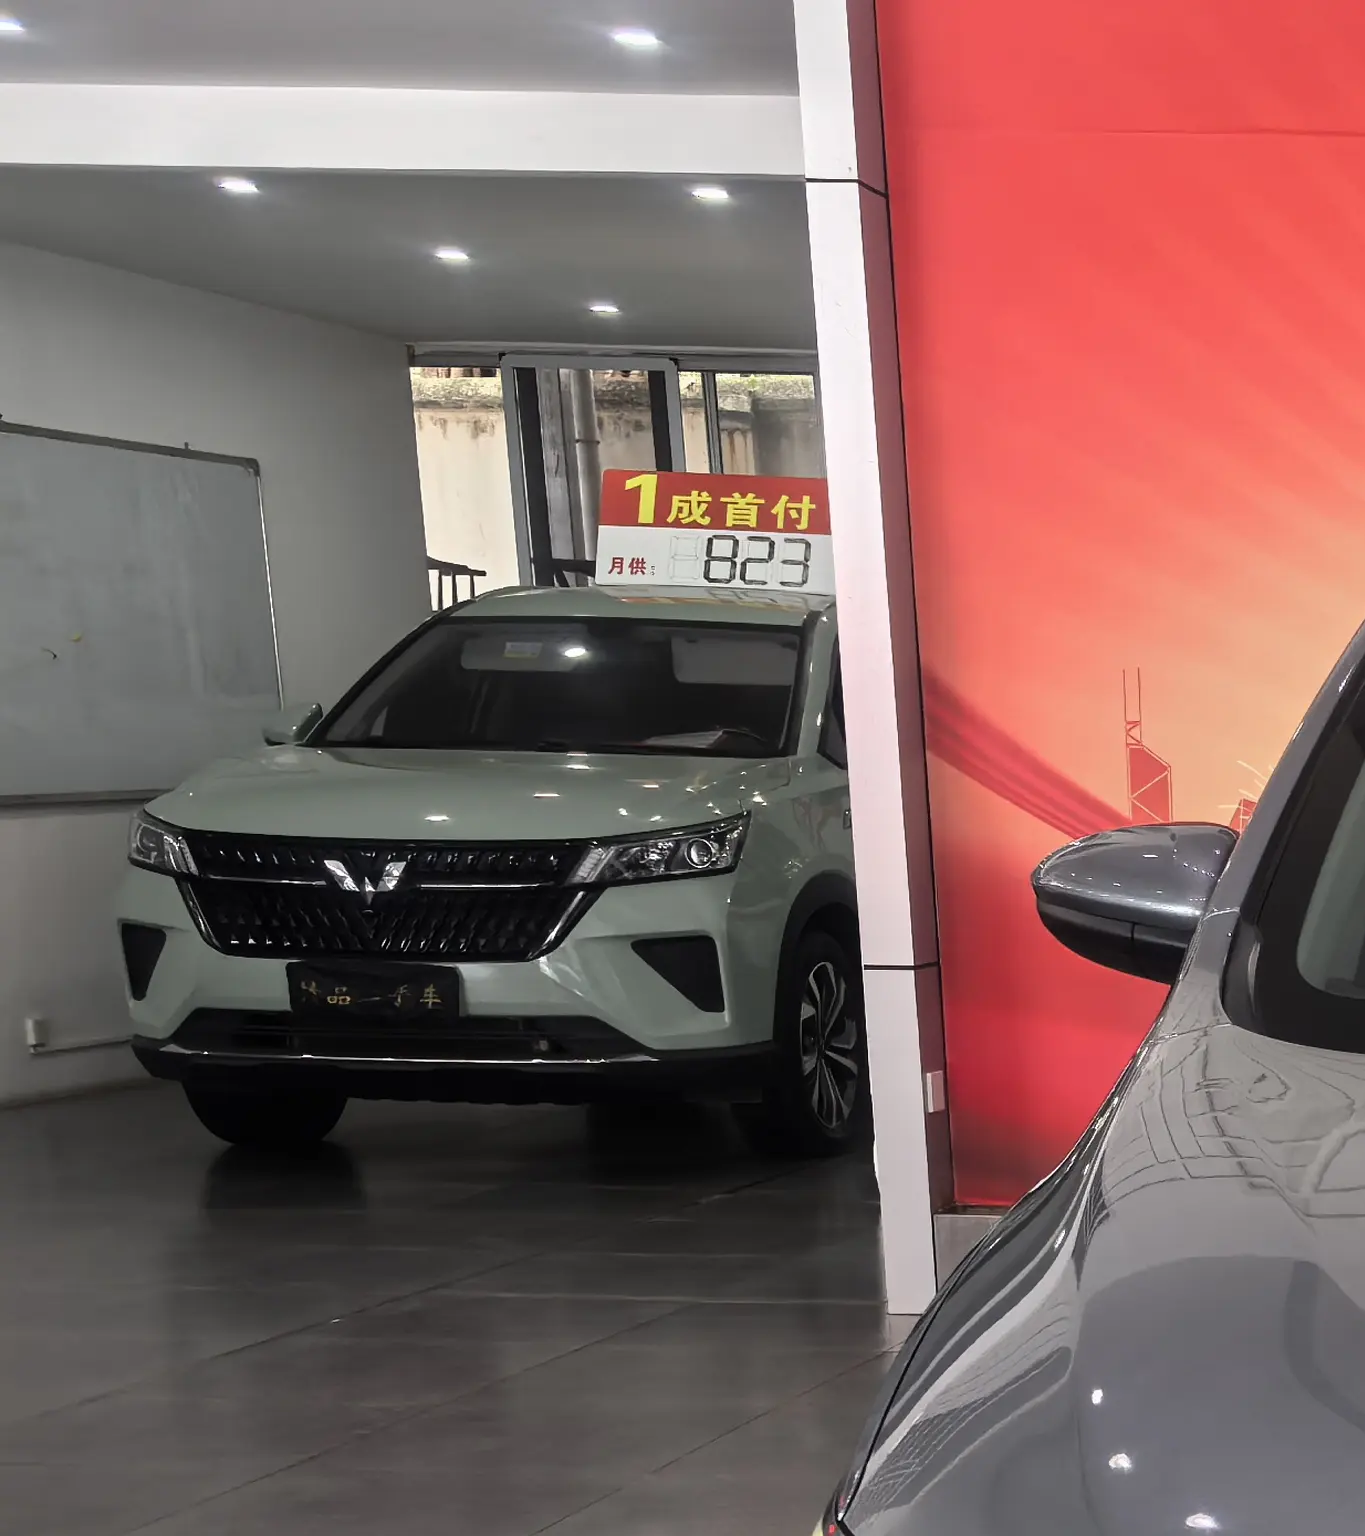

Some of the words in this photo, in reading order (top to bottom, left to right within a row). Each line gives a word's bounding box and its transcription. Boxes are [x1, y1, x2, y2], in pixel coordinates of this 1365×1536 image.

[624, 474, 816, 530] 1成首付
[703, 534, 811, 588] 823
